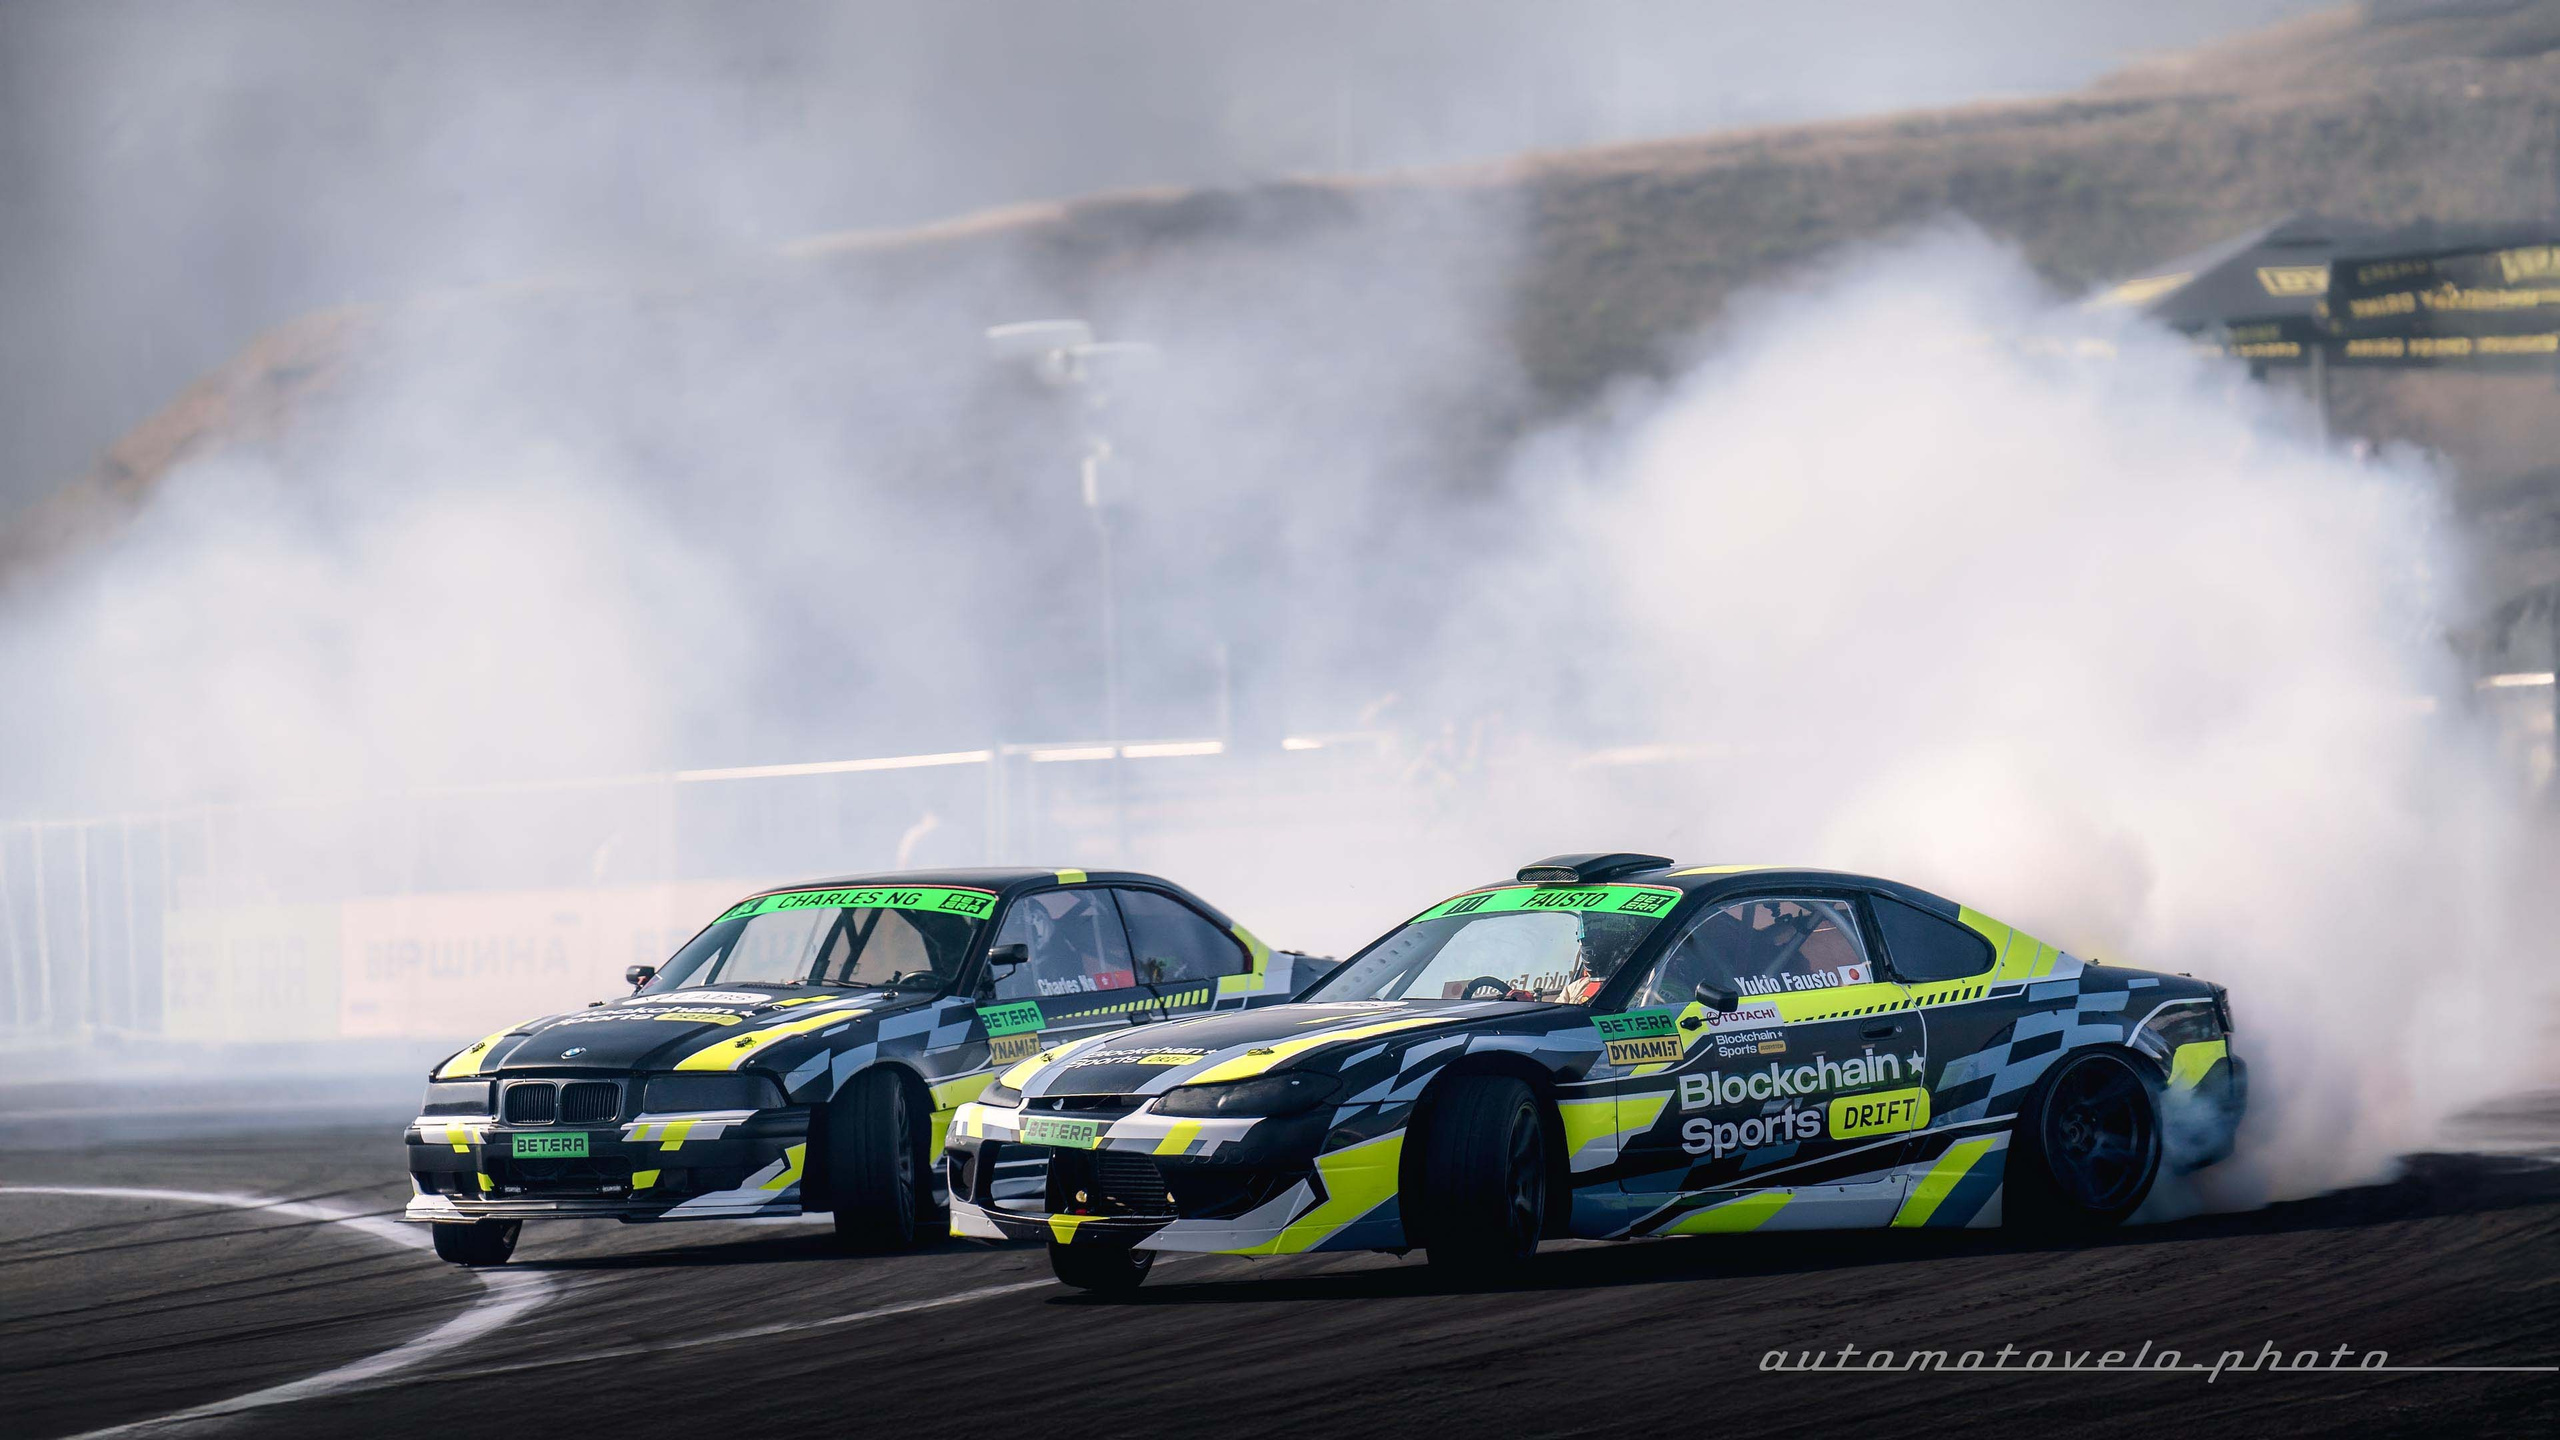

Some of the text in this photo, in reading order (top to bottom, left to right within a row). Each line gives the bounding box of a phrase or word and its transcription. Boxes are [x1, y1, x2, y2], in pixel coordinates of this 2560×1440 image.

[778, 892, 922, 909] CHARLES NG
[950, 895, 989, 905] BET
[1520, 892, 1608, 908] FAUSTO
[1633, 894, 1671, 903] BET
[1037, 977, 1077, 995] Charles
[1733, 970, 1838, 996] Yukio Fausto
[1722, 1010, 1775, 1023] TOTACHI
[1716, 1031, 1777, 1045] Blockchain
[1719, 1041, 1758, 1058] Sports
[1679, 1048, 1900, 1110] Blockchain
[1681, 1098, 1916, 1158] Sports DRIFT
